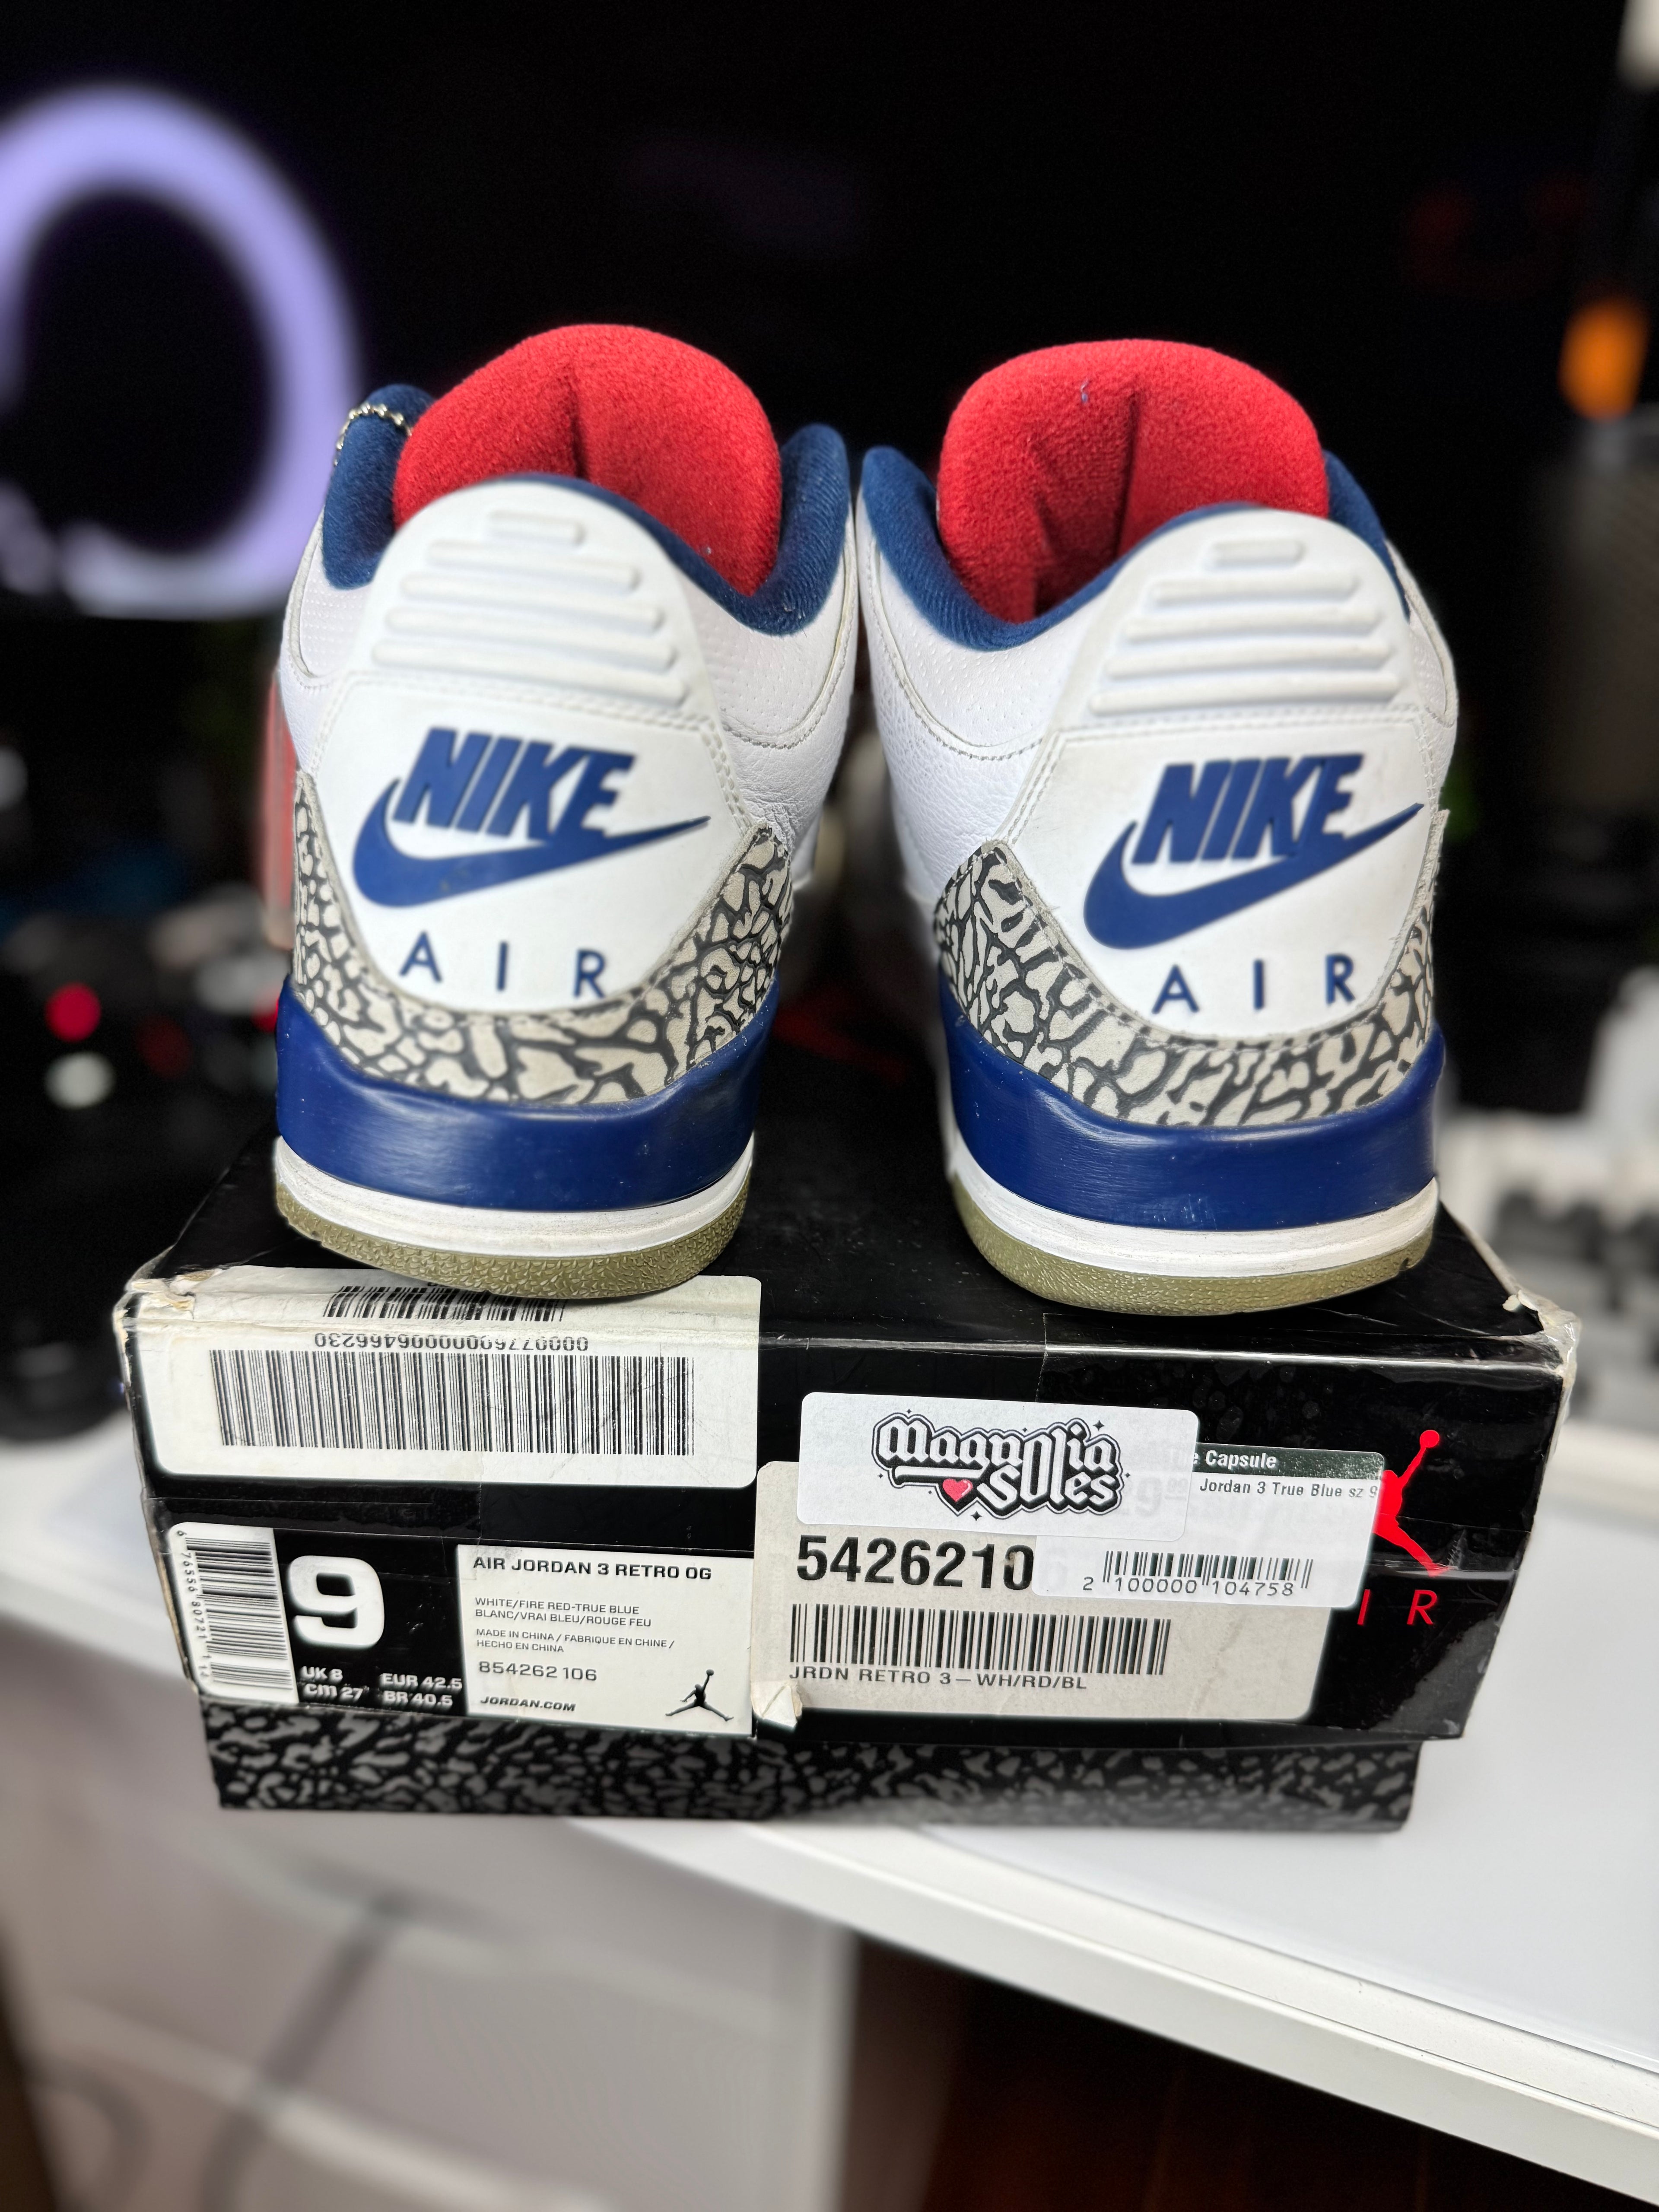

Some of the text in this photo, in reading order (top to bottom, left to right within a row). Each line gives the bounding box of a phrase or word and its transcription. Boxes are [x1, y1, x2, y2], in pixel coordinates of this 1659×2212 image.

[392, 726, 637, 843] NIKE
[1130, 753, 1364, 864] NIKE
[399, 931, 606, 999] AIR
[1151, 953, 1355, 1014] AIR
[1206, 1450, 1277, 1470] Capsule
[1200, 1478, 1251, 1494] Jordan
[1257, 1481, 1266, 1494] 3
[1273, 1482, 1304, 1496] True
[1311, 1484, 1342, 1497] Blue
[1348, 1488, 1363, 1498] sz
[473, 1557, 712, 1580] AIR JORDAN 3 RETRO OG
[1082, 1576, 1294, 1596] 2 100000 104758
[289, 1555, 385, 1650] 9
[475, 1597, 639, 1615] WHITE/FIRE RED-TRUE BLUE
[1357, 1589, 1438, 1626] IR
[475, 1609, 651, 1627] BLANC/VRAI BLEU/ROUGE FEU
[476, 1628, 506, 1637] MADE
[522, 1631, 555, 1641] CHINA
[565, 1634, 616, 1644] FABRIQUE
[635, 1638, 667, 1647] CHINE
[477, 1640, 513, 1649] HECHO
[532, 1643, 564, 1653] CHINA
[302, 1666, 463, 1691] UK 8 EUR 42.5
[789, 1665, 849, 1680] JRDN
[858, 1668, 931, 1684] RETRO
[939, 1672, 951, 1684] 3
[976, 1673, 1087, 1689] WH/RD/BL
[339, 1686, 364, 1701] 27
[382, 1690, 409, 1705] BR
[411, 1693, 453, 1707] 40.5
[480, 1696, 576, 1712] JORDAN.COM
